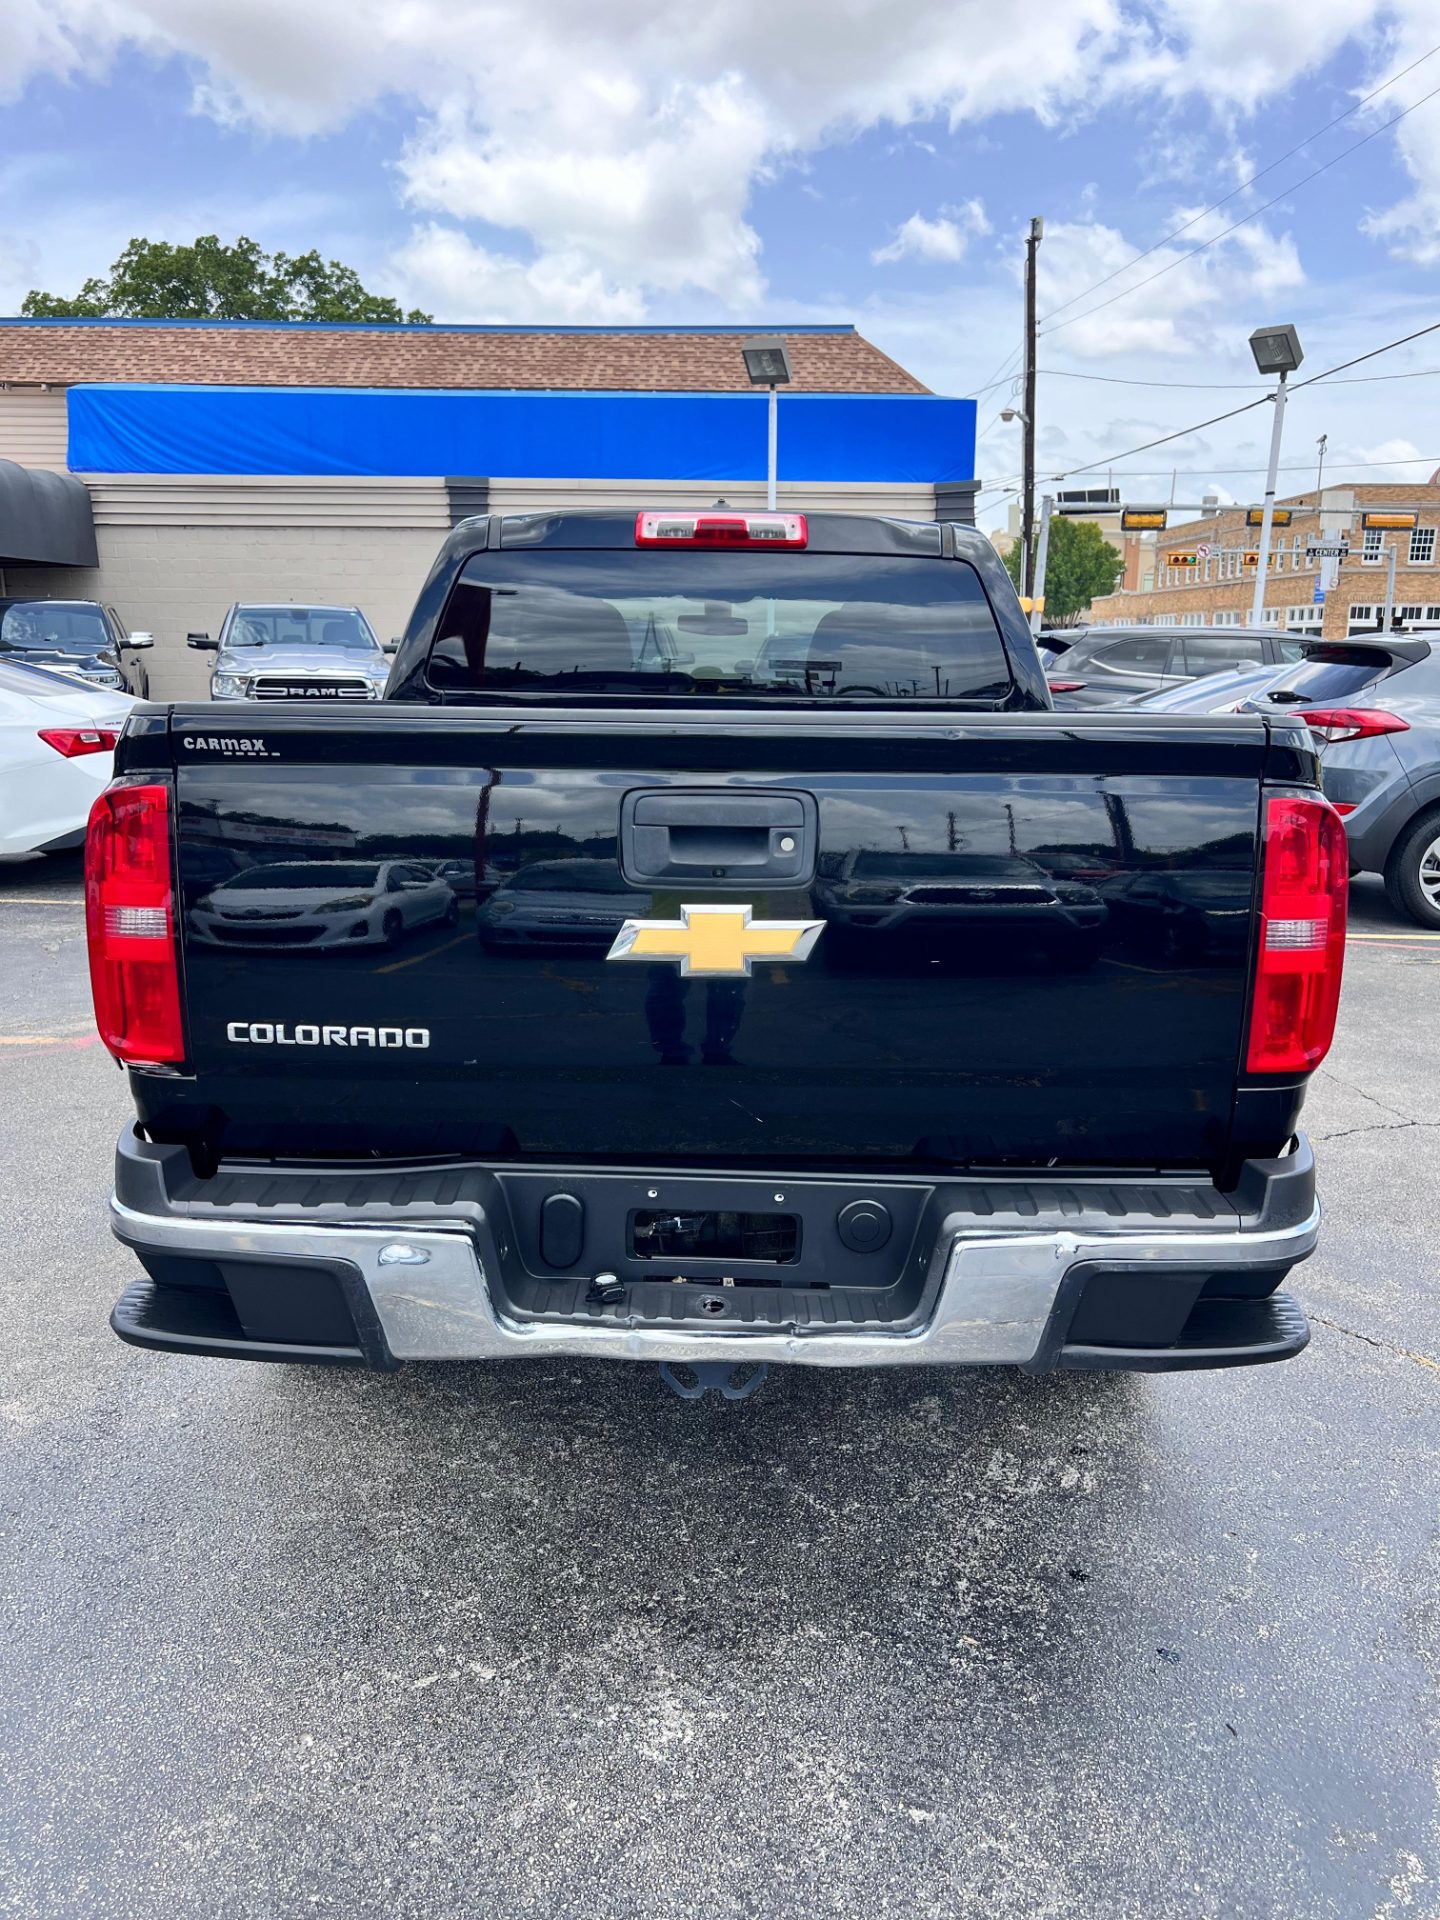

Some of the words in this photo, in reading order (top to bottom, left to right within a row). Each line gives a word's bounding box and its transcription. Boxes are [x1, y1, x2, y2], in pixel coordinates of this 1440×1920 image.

[1315, 549, 1339, 557] CENTER
[289, 687, 337, 696] RAM
[227, 1022, 430, 1048] COLORADO
